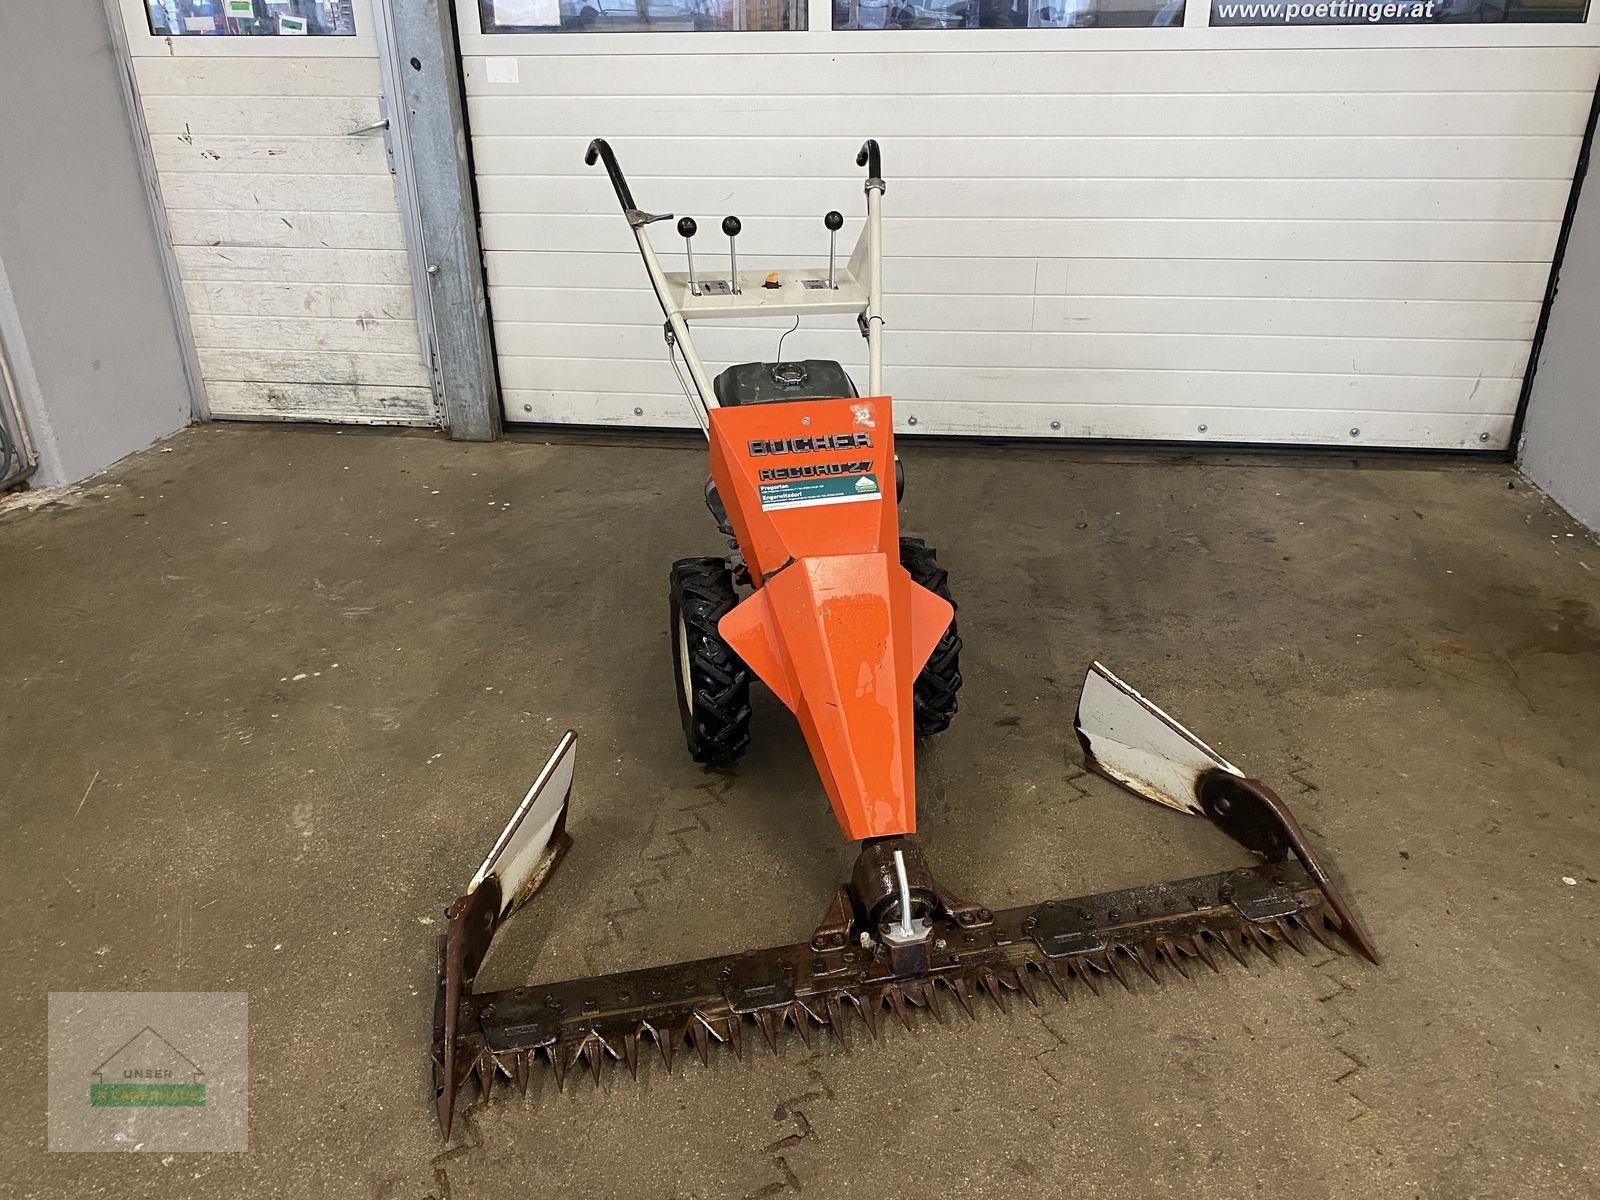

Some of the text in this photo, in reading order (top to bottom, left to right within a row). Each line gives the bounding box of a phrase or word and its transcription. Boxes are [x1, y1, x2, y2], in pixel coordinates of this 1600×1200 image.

[1218, 0, 1435, 21] www.poettinger.at
[748, 432, 873, 457] BUCHER
[759, 460, 873, 481] RECORD 27
